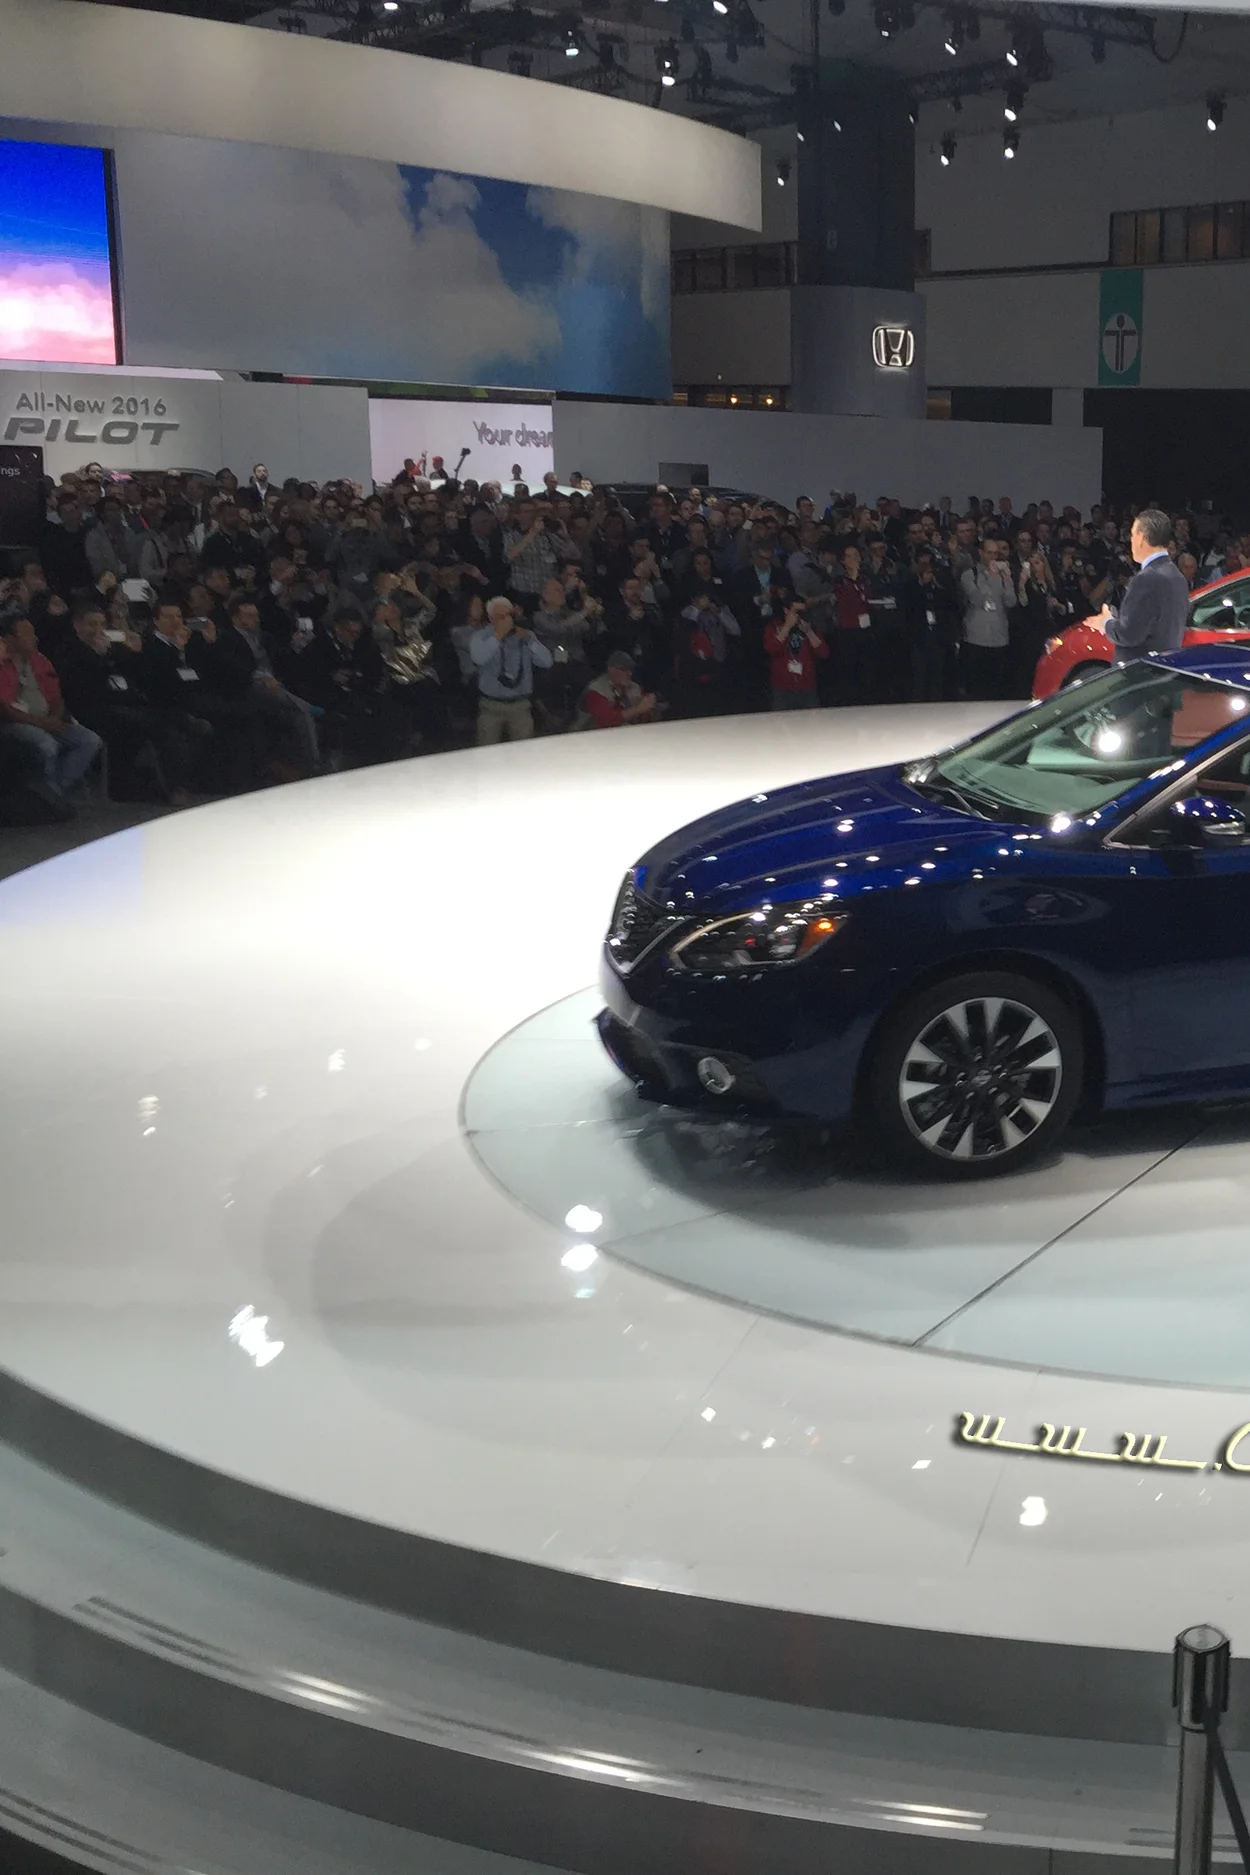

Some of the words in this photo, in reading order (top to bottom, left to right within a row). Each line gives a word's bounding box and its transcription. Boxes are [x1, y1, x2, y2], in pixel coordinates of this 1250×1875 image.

[15, 391, 105, 414] All-New
[111, 396, 168, 416] 2016
[4, 416, 181, 446] PILOT
[473, 420, 513, 446] Your
